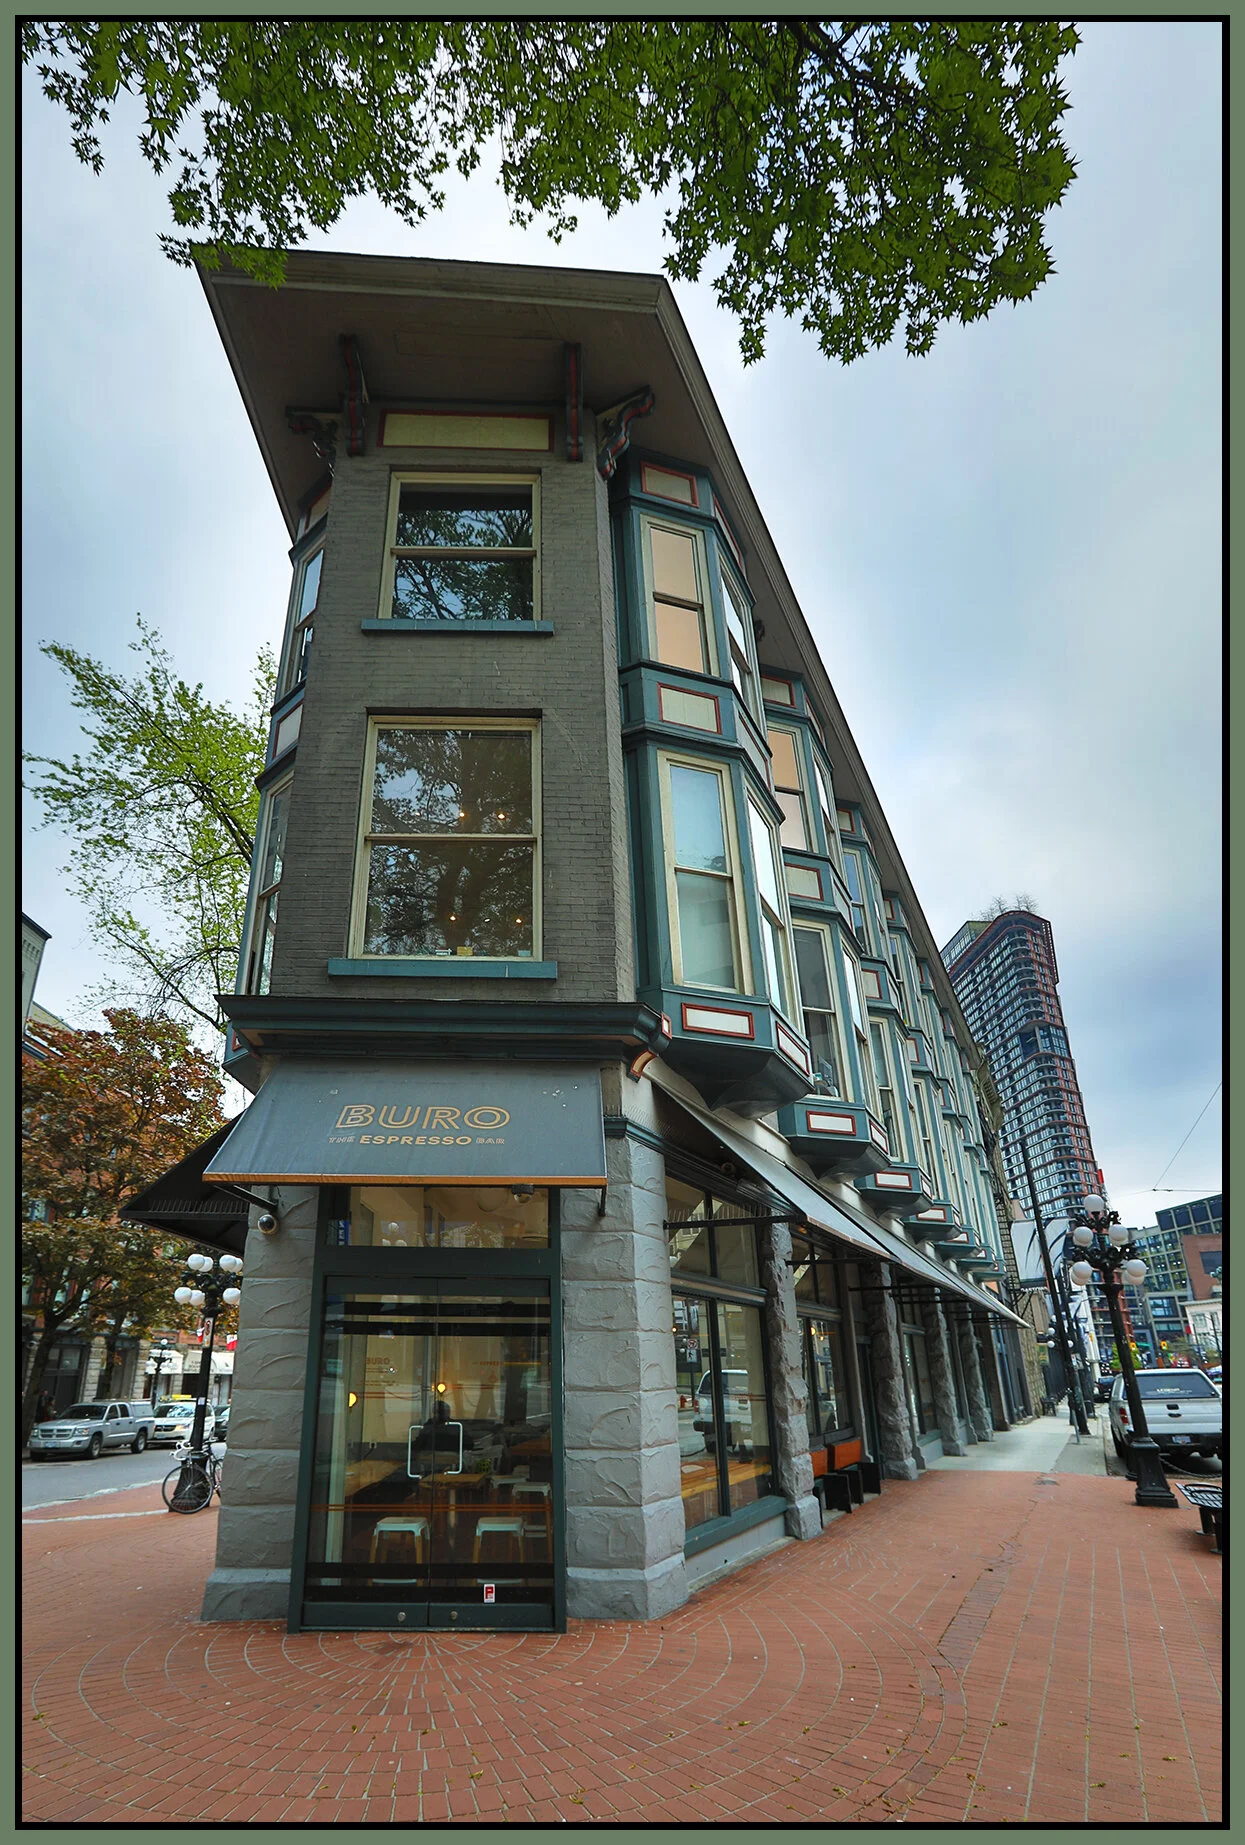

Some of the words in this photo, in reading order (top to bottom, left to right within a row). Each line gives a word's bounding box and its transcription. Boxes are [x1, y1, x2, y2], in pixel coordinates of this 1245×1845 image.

[335, 1104, 511, 1129] BURO
[328, 1135, 357, 1144] THE
[359, 1135, 472, 1145] ESPRESSO
[475, 1136, 505, 1145] BAR
